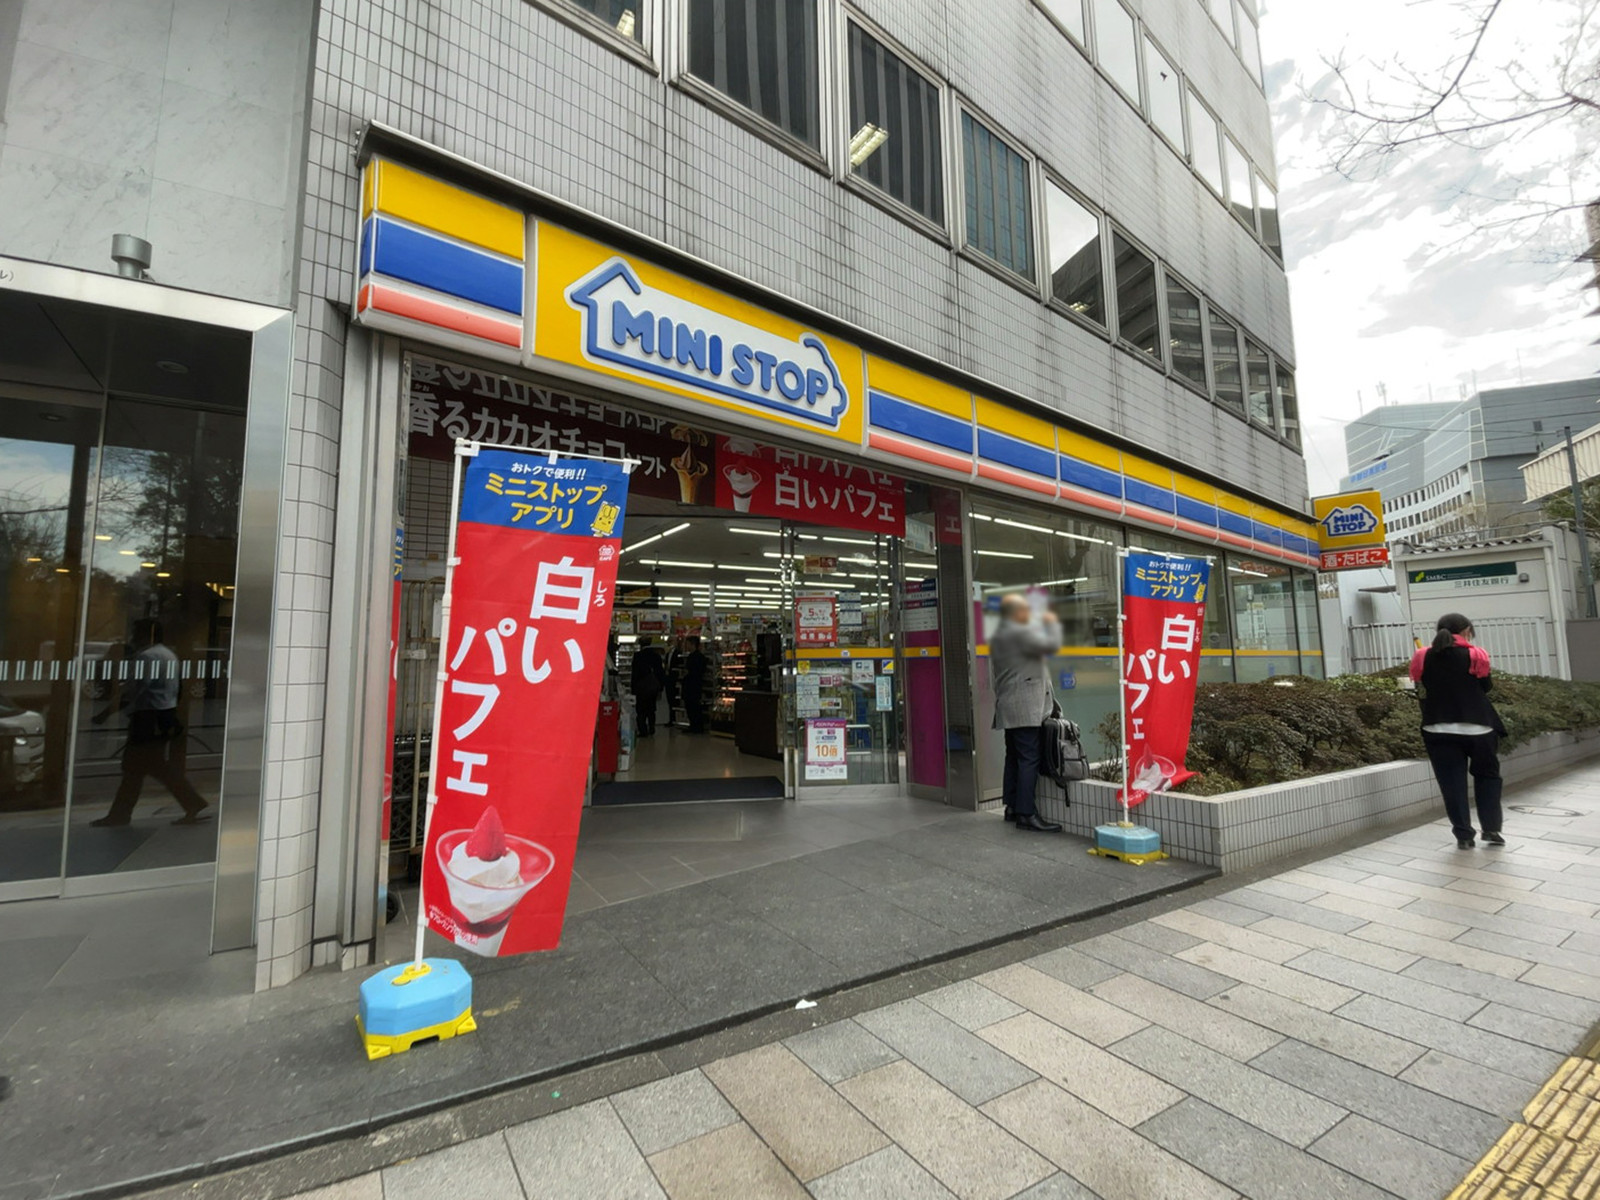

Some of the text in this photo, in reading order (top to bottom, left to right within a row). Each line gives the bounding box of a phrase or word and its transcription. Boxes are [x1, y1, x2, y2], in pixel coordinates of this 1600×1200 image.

[612, 300, 723, 377] MINI
[731, 343, 829, 405] STOP
[485, 472, 608, 506] ミニストップ
[775, 470, 896, 523] 白いパフェ
[511, 502, 574, 529] アプリ
[1333, 512, 1365, 524] MINI
[1333, 521, 1366, 533] STOP
[1135, 567, 1202, 586] ミニストップ
[1150, 584, 1184, 599] アプリ
[1425, 573, 1446, 581] SMBC
[593, 580, 608, 607] しろ
[521, 555, 595, 684] 白い
[1157, 613, 1196, 684] 白い
[446, 617, 518, 797] パフェ
[1126, 648, 1156, 740] パフェ
